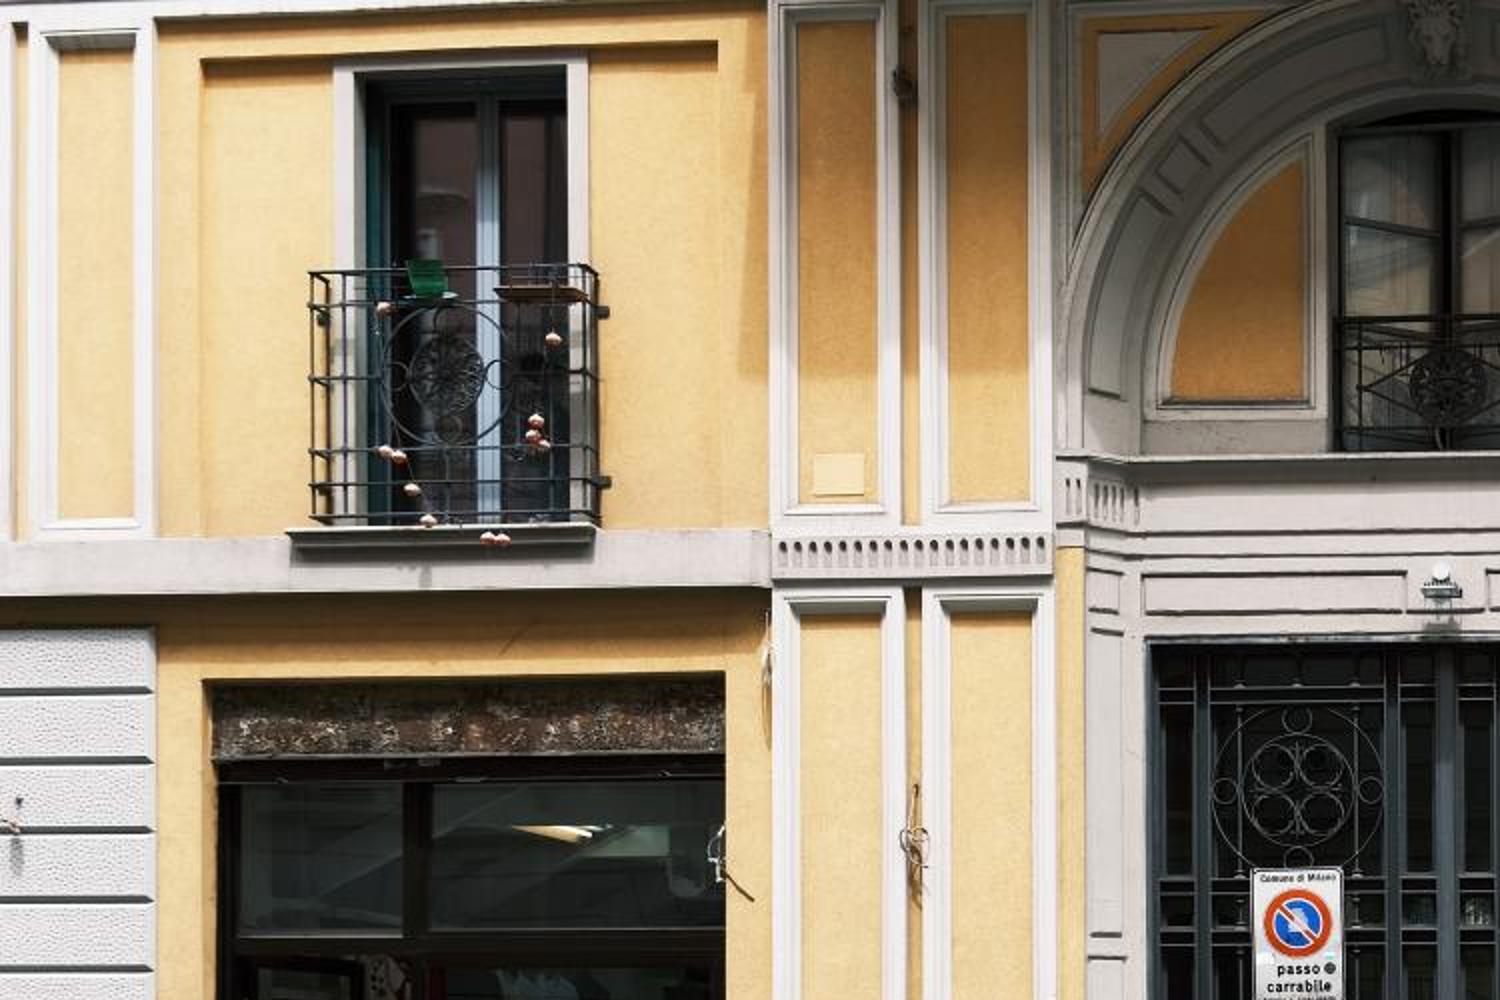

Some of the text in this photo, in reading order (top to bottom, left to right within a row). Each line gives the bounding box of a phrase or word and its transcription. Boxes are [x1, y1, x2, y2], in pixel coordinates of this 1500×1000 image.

[1259, 873, 1337, 883] Comune di Milano
[1277, 965, 1321, 978] passo
[1267, 979, 1332, 993] carrabile
